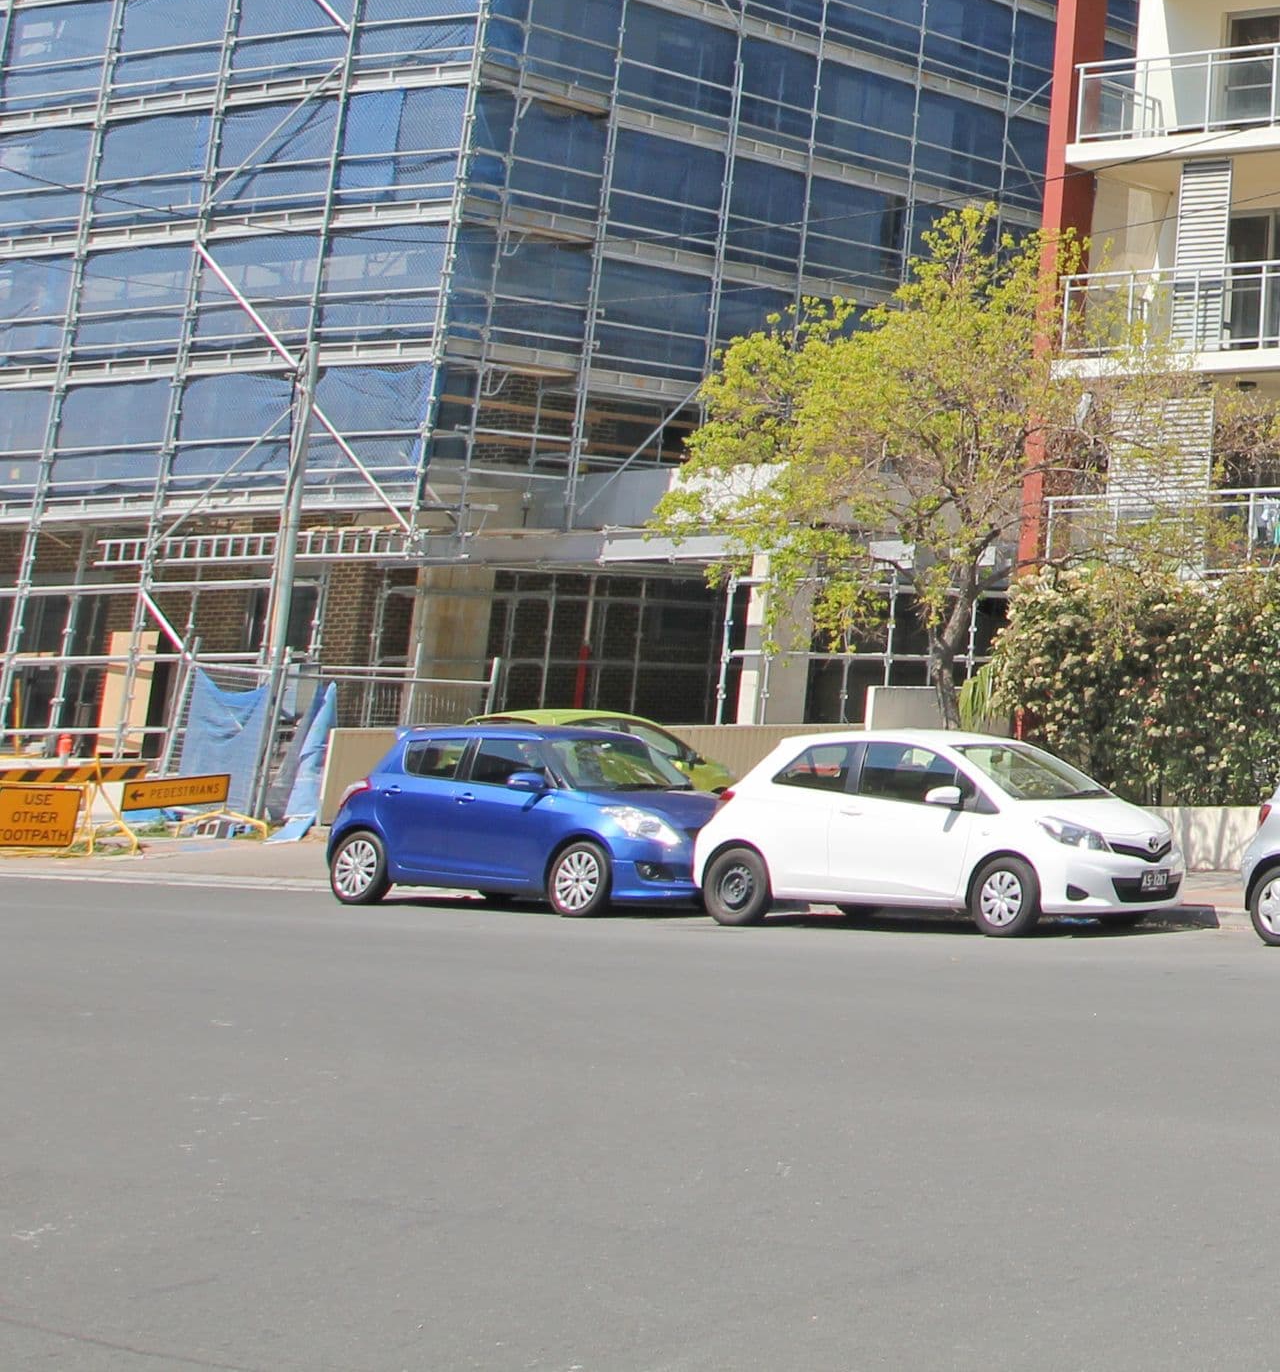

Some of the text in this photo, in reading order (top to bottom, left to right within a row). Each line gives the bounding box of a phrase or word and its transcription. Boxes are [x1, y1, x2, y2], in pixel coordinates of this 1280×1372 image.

[150, 782, 220, 799] PEDESTRIANS
[25, 793, 53, 806] USE
[11, 811, 59, 824] OTHER
[0, 828, 69, 841] OOTPATH
